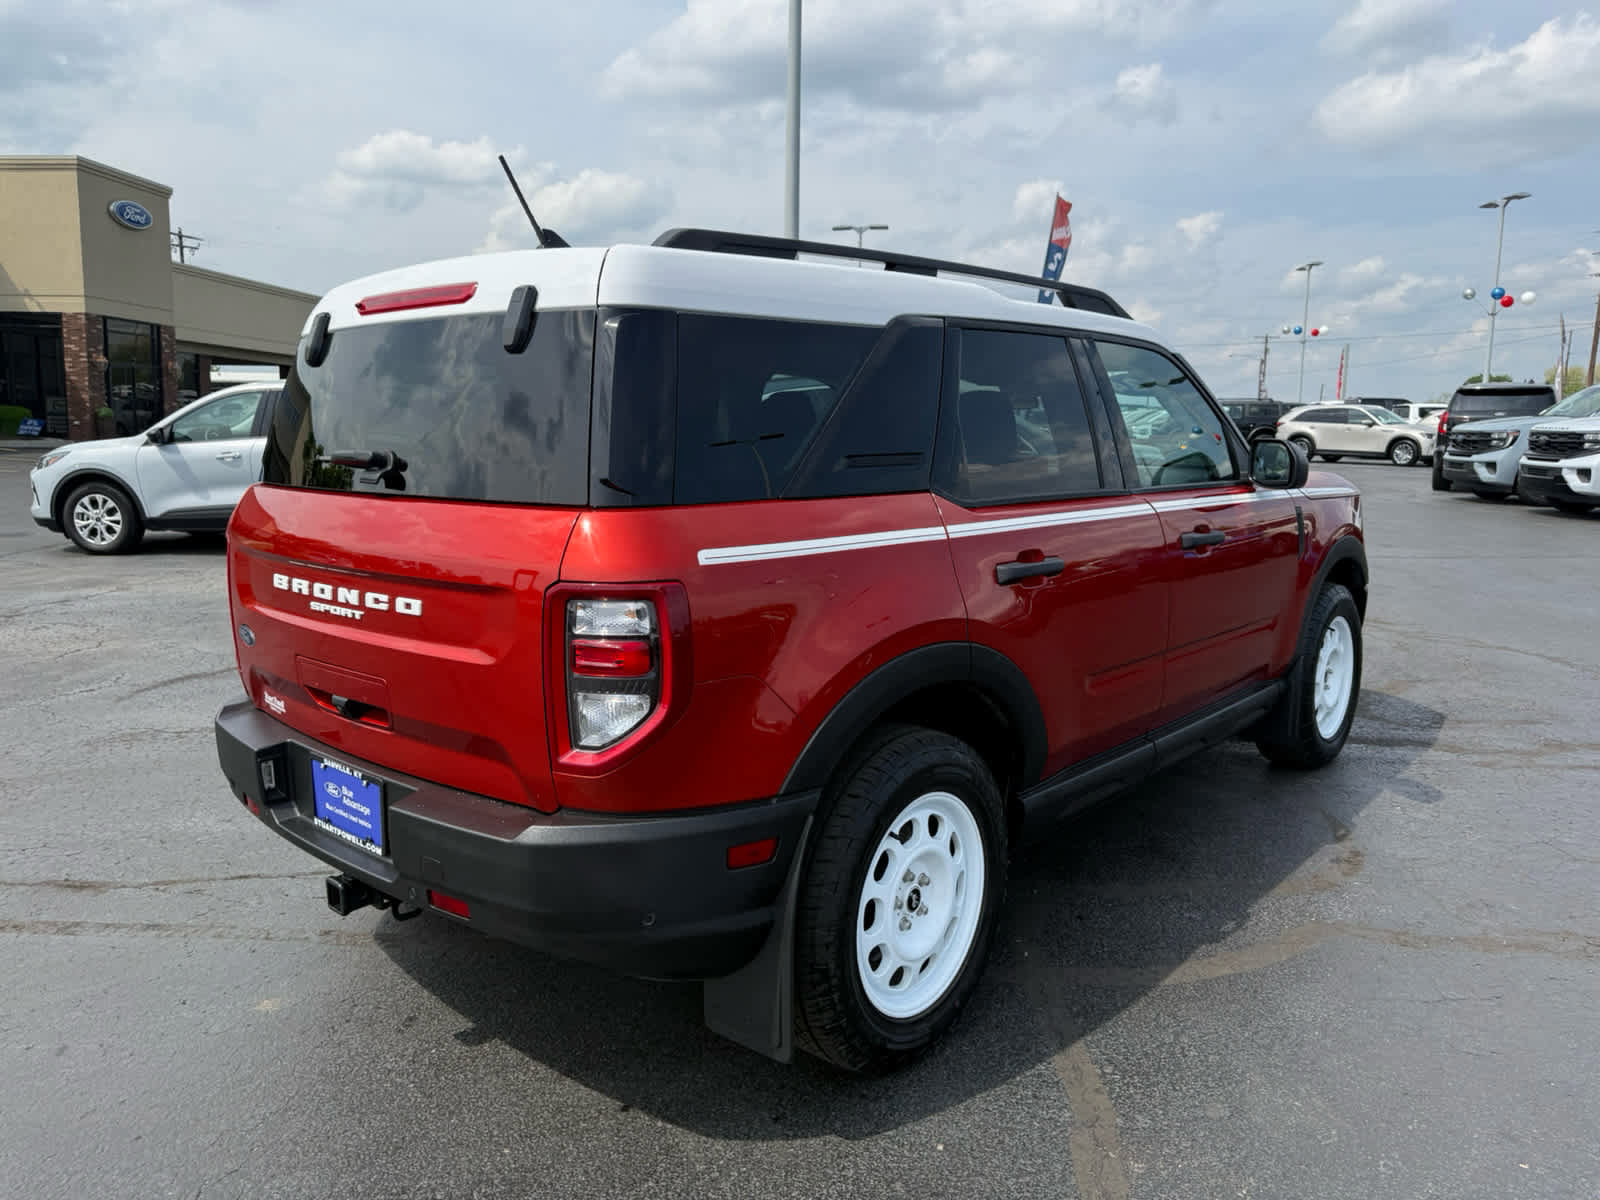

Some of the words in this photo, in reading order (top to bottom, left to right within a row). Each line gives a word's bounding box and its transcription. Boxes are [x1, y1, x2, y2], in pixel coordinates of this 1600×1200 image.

[123, 206, 146, 224] Ford
[273, 573, 422, 616] BRONCO
[310, 601, 365, 620] SPORT
[314, 817, 382, 856] STUARTPOWELL.COM
